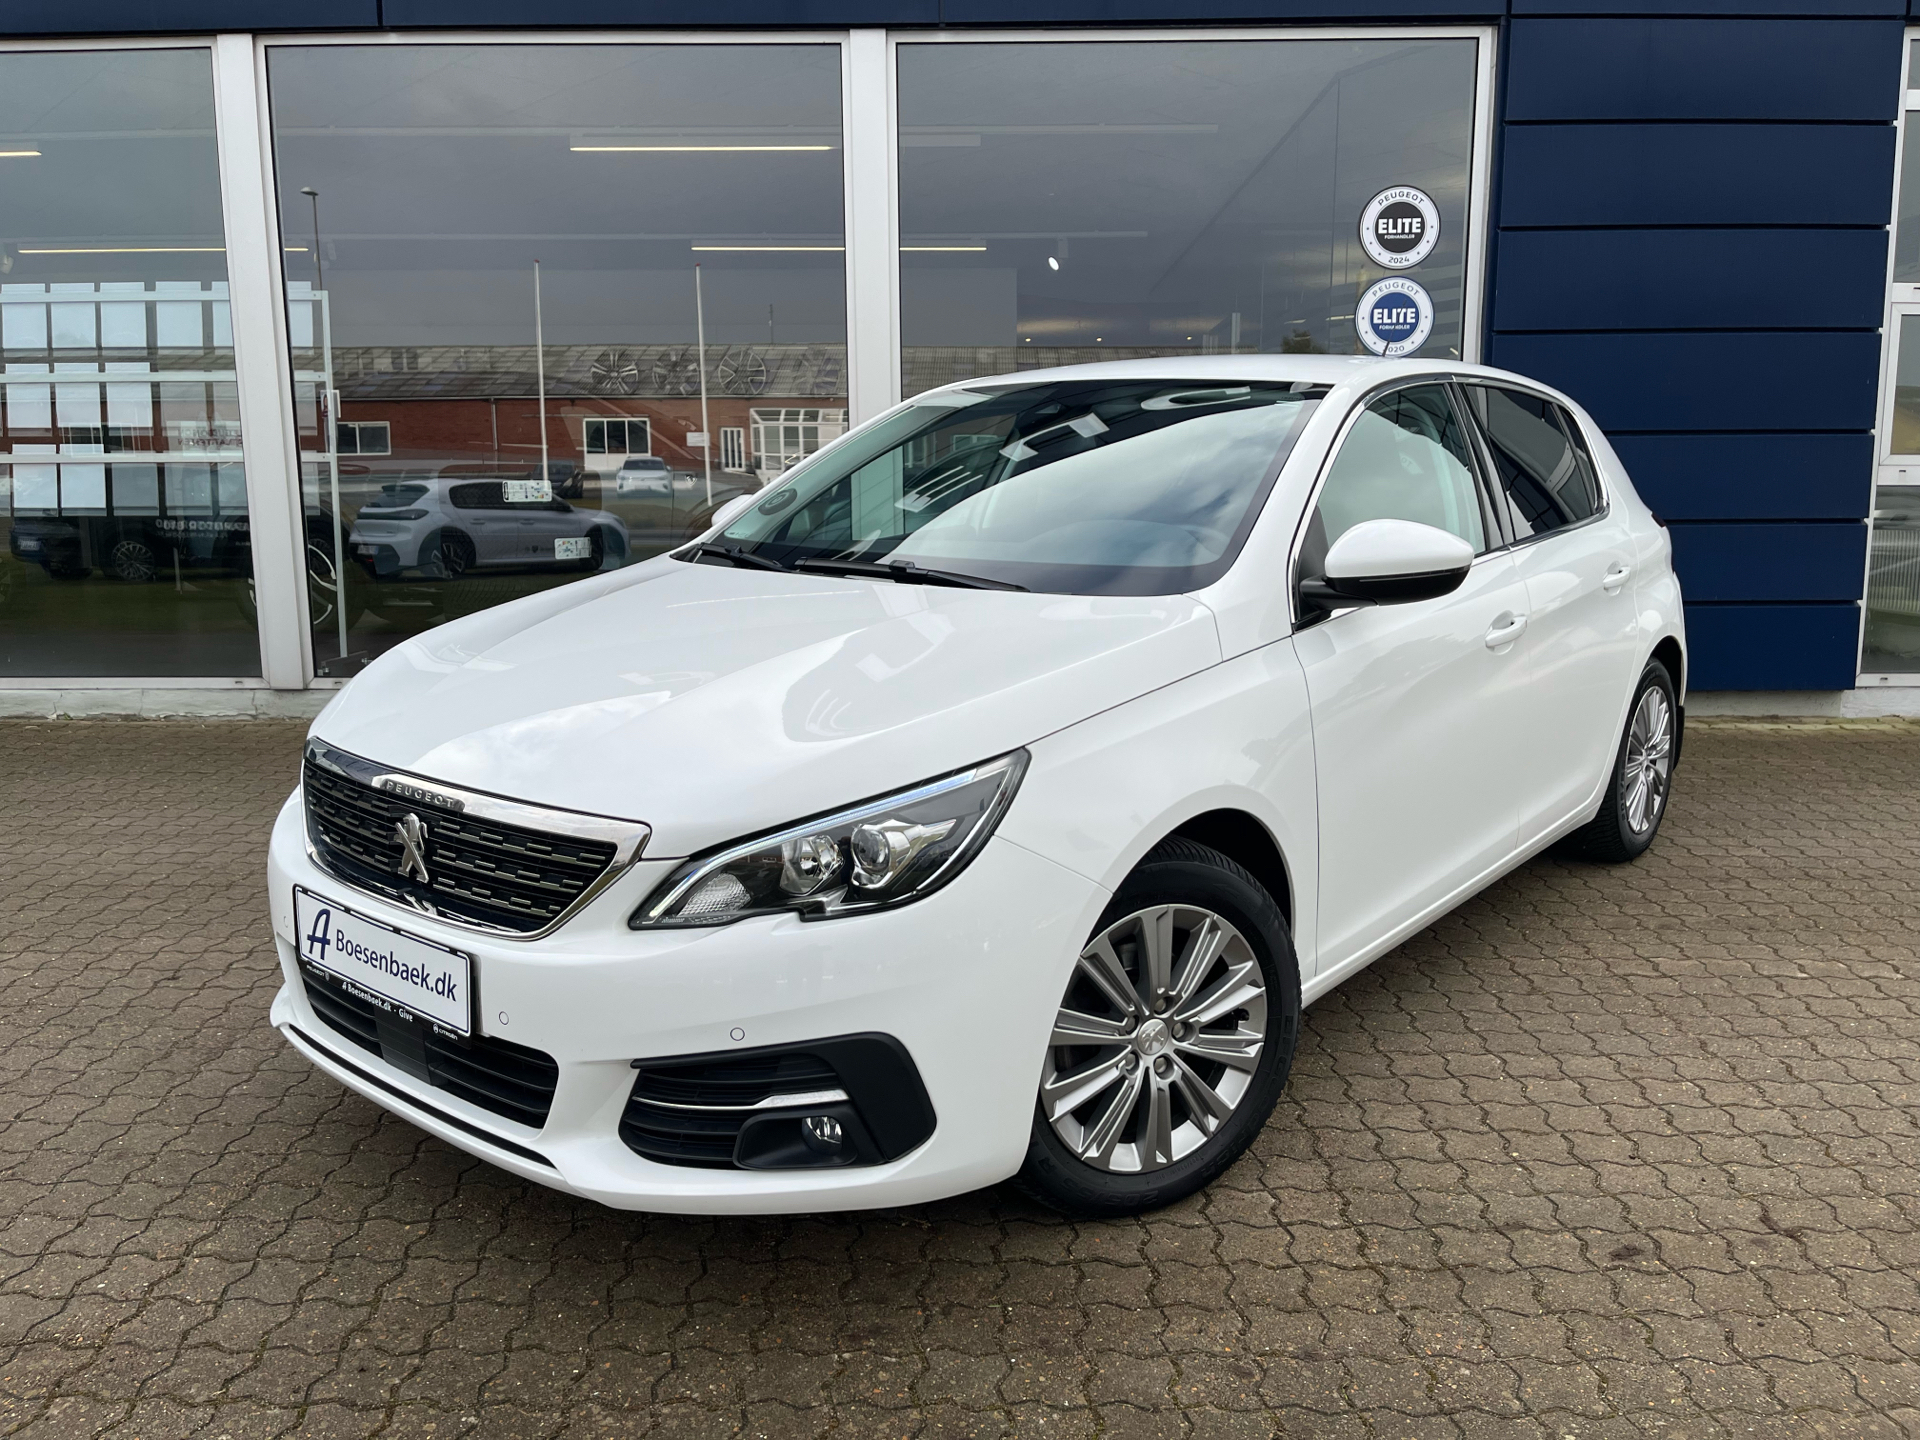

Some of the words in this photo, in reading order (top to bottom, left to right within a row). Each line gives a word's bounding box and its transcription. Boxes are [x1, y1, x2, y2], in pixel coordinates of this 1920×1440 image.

[1377, 190, 1425, 206] PEUGEOT
[1378, 217, 1422, 234] ELITE
[1388, 256, 1410, 264] 2024
[1371, 281, 1420, 297] PEUGEOT
[1373, 308, 1416, 324] ELITE
[385, 780, 454, 808] PEUGEOT
[336, 929, 458, 1002] Boesenbaek.dk
[347, 983, 392, 1012] Boesenbaek.dk
[398, 1007, 413, 1022] Give
